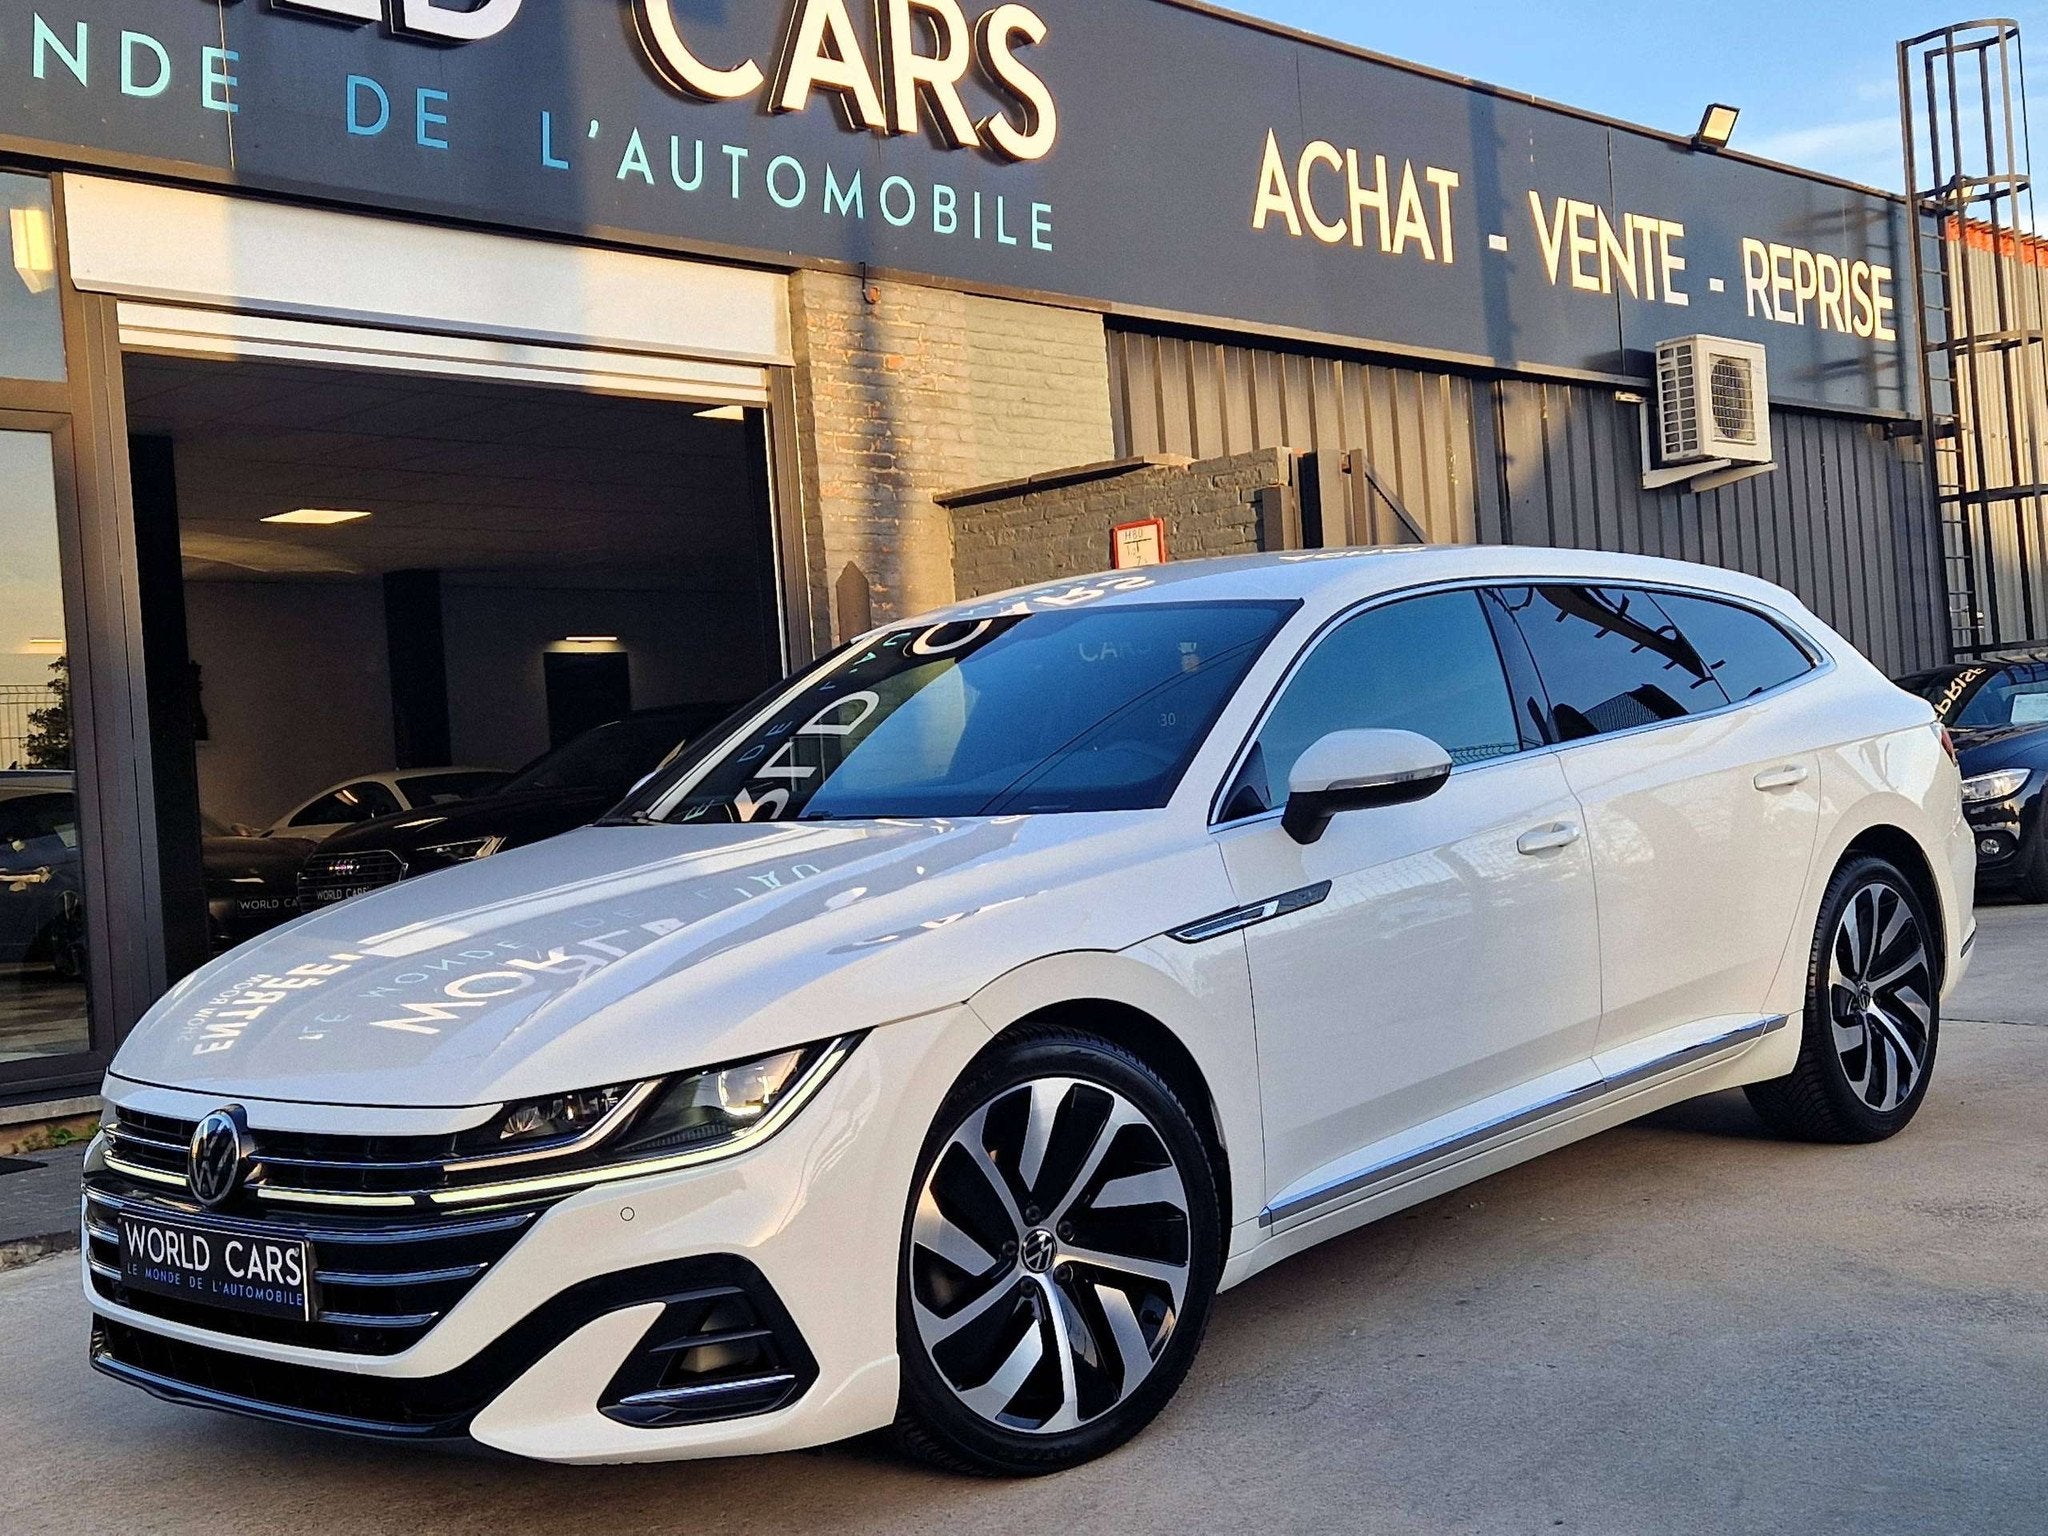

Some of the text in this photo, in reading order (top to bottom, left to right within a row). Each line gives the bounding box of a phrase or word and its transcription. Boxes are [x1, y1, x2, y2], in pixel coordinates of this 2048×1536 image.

[347, 75, 450, 149] DE
[541, 111, 1054, 251] L'AUTOMOBILE
[1252, 127, 1459, 264] ACHAT
[1528, 190, 1689, 307] VENTE
[1742, 237, 1898, 342] REPRISE
[239, 900, 279, 911] WORLD
[125, 1221, 302, 1286] WORLD CARS
[127, 1262, 303, 1306] LE MONDE DE L'AUTOMOBILE
